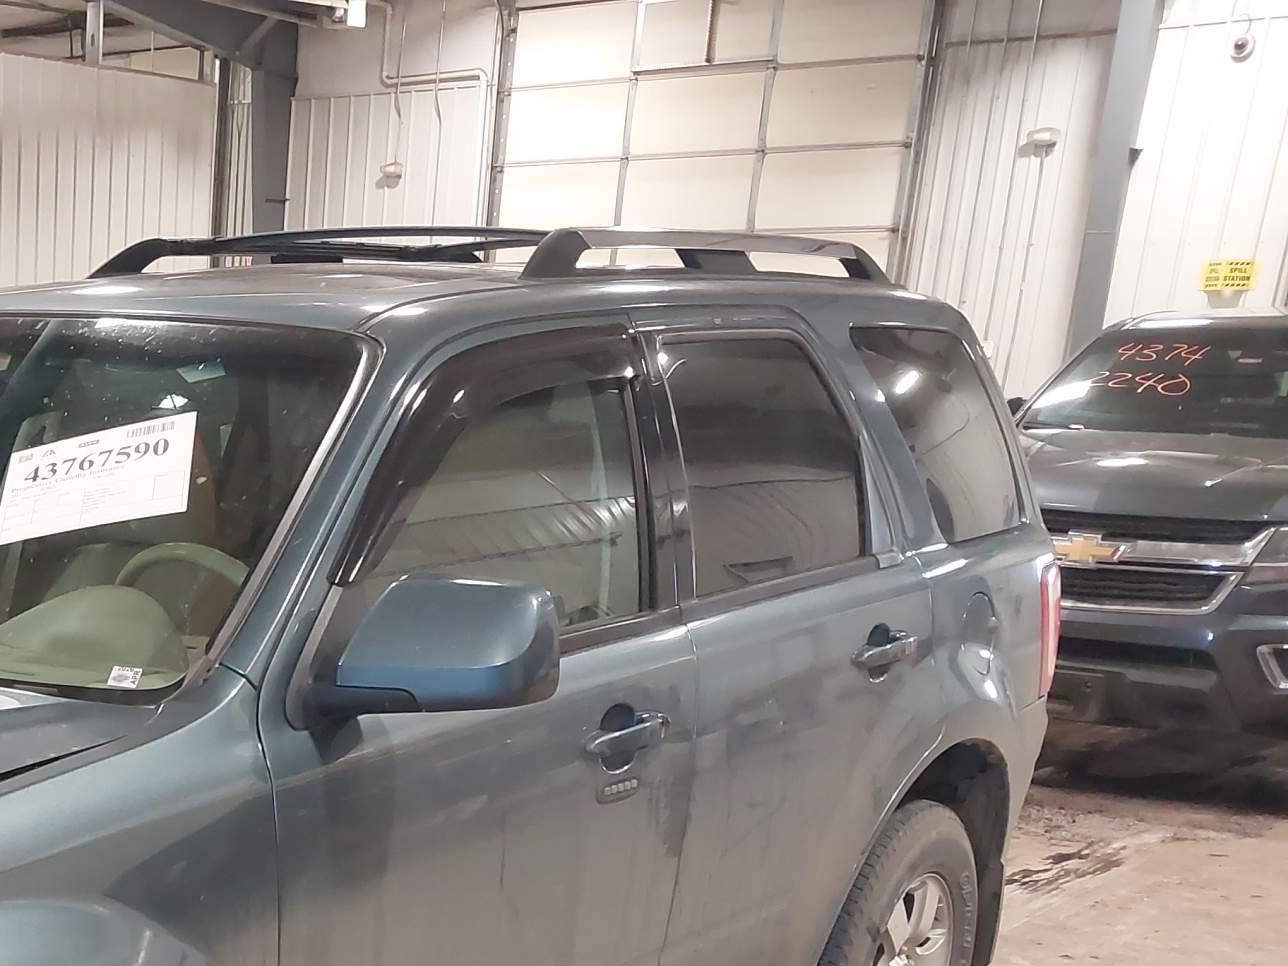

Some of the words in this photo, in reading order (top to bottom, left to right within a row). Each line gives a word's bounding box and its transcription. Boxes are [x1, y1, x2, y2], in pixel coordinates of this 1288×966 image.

[1118, 343, 1211, 366] 4374
[1090, 371, 1190, 395] 2240
[24, 438, 169, 482] 43767590
